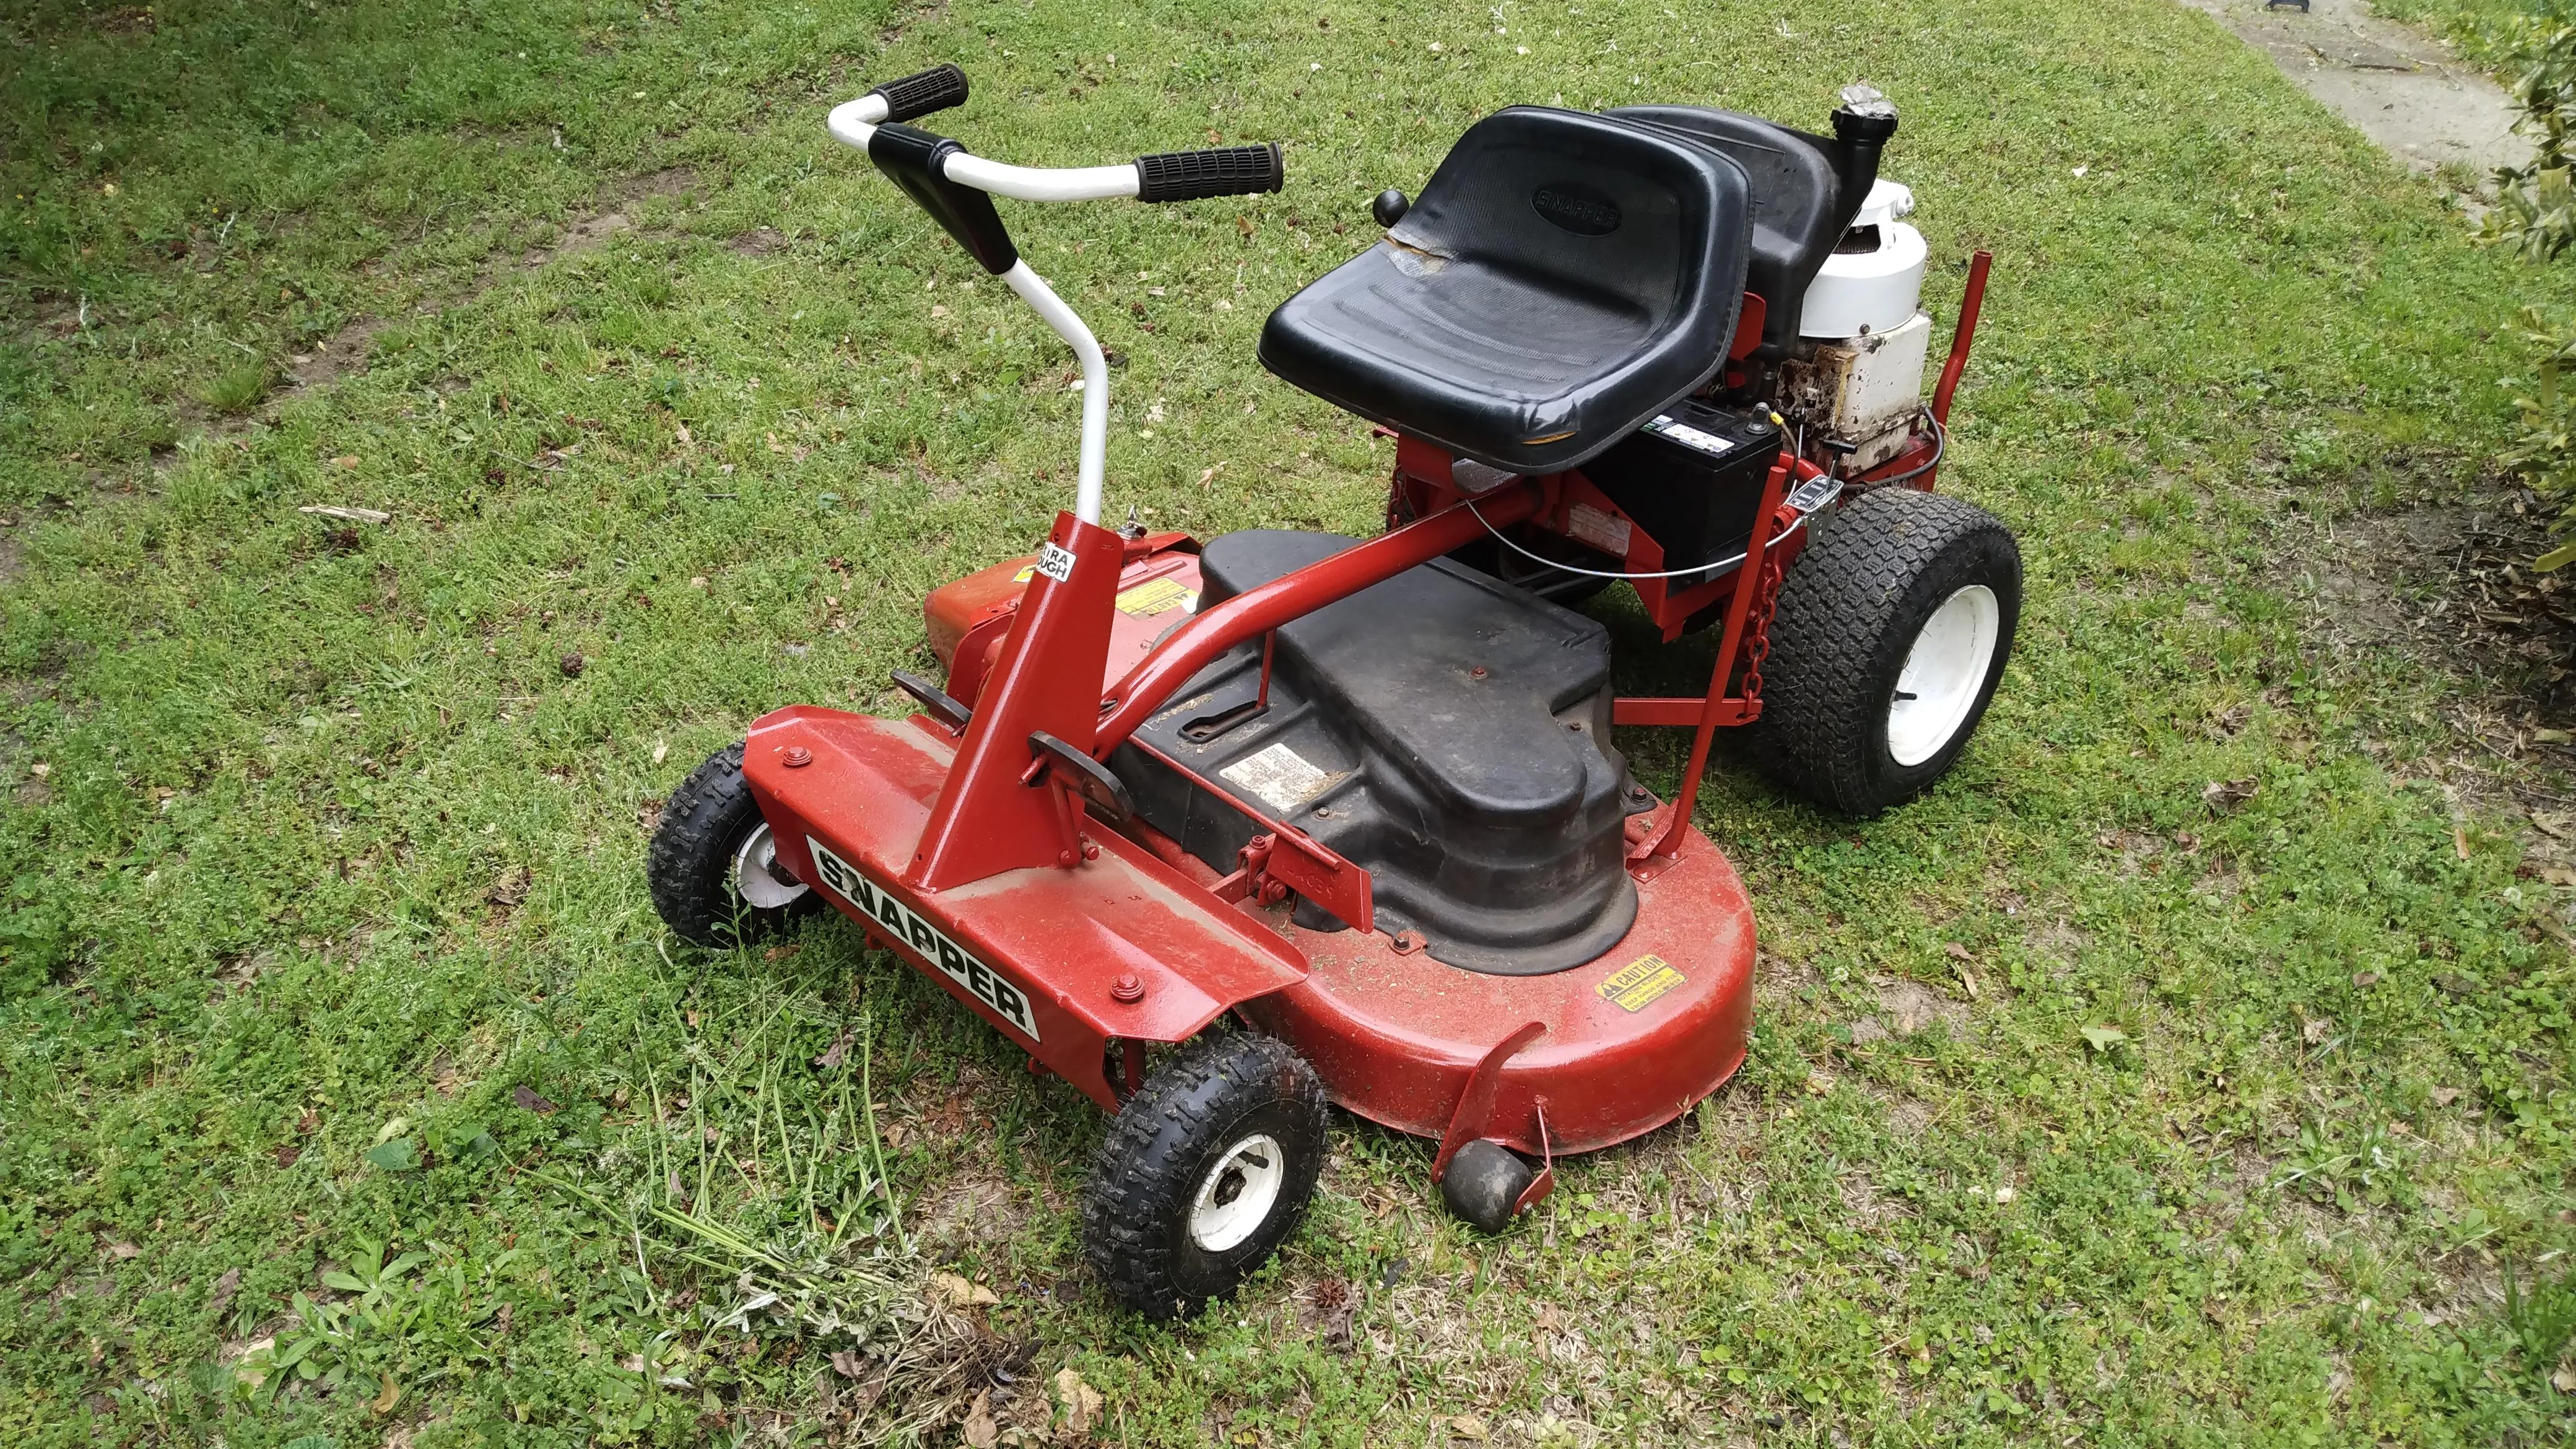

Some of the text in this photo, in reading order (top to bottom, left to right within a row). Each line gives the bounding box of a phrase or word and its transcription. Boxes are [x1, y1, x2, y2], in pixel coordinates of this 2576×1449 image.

[1536, 190, 1618, 227] SNAPPER
[819, 849, 1026, 1027] SNAPPER
[1616, 955, 1663, 986] CAUTION
